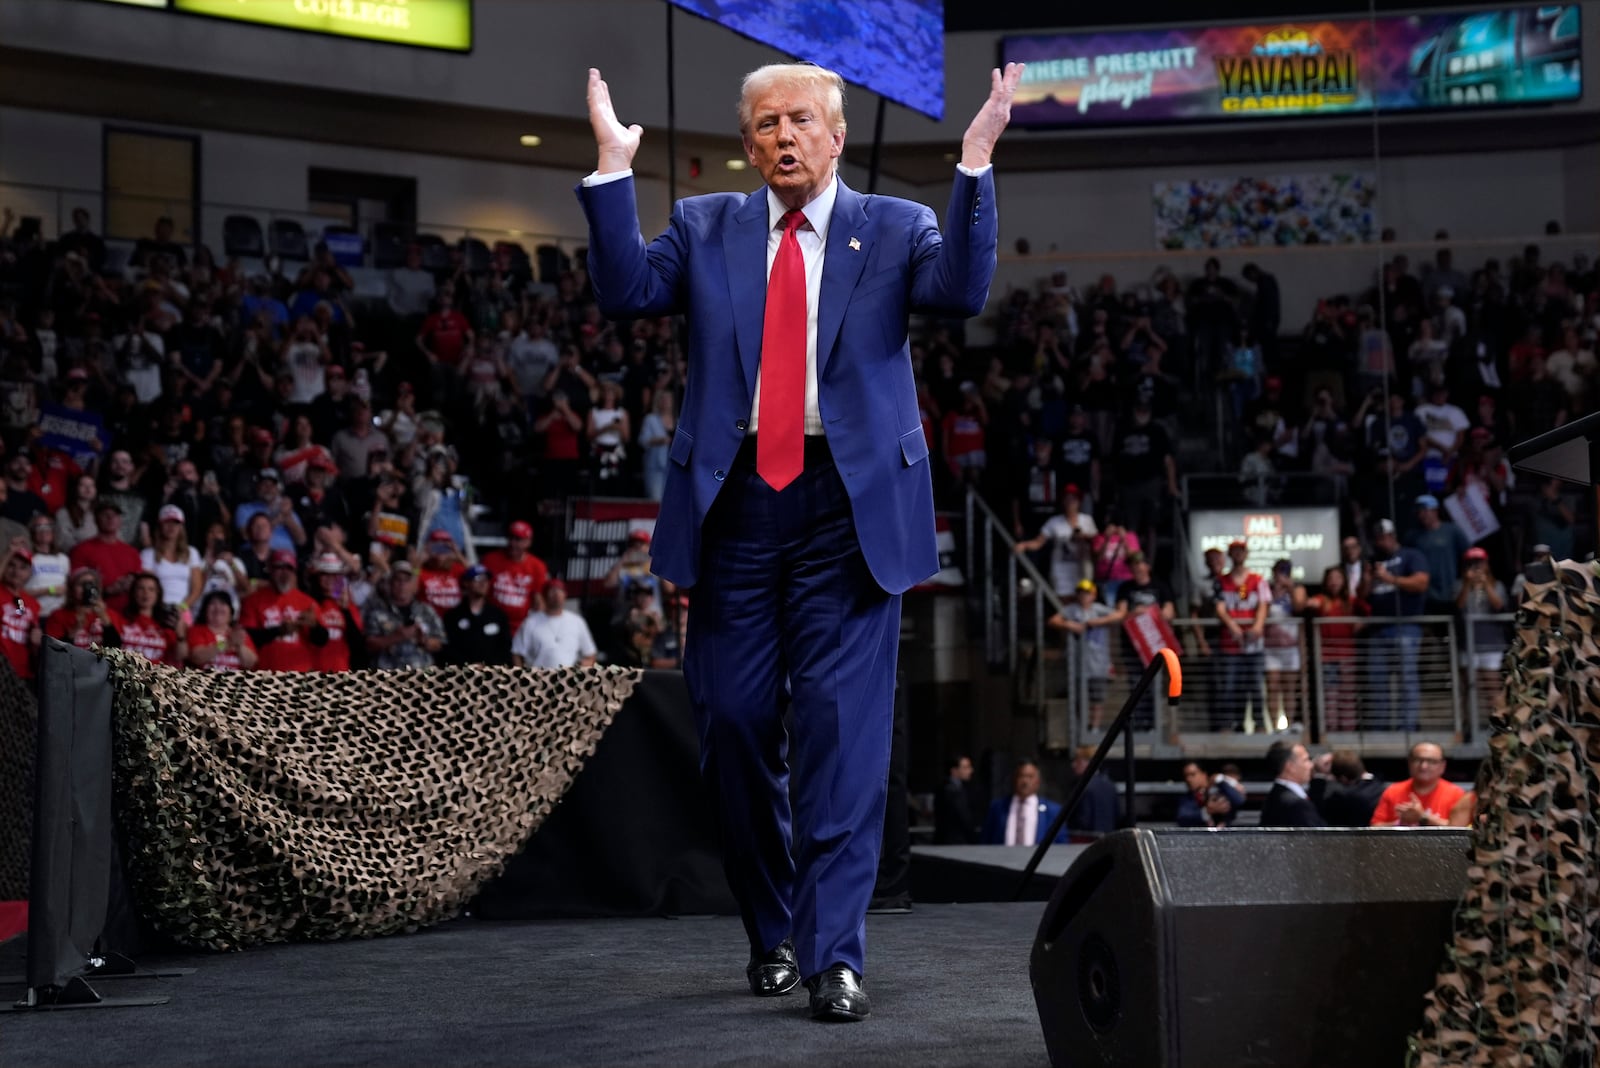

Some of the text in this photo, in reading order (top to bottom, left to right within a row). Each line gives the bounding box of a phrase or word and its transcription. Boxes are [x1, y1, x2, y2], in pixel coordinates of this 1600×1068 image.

[1094, 46, 1197, 75] PRESKITT
[1215, 51, 1356, 96] YAVAPAI
[1222, 93, 1324, 112] CASINO
[1248, 517, 1277, 533] ML
[1284, 533, 1324, 550] LAW
